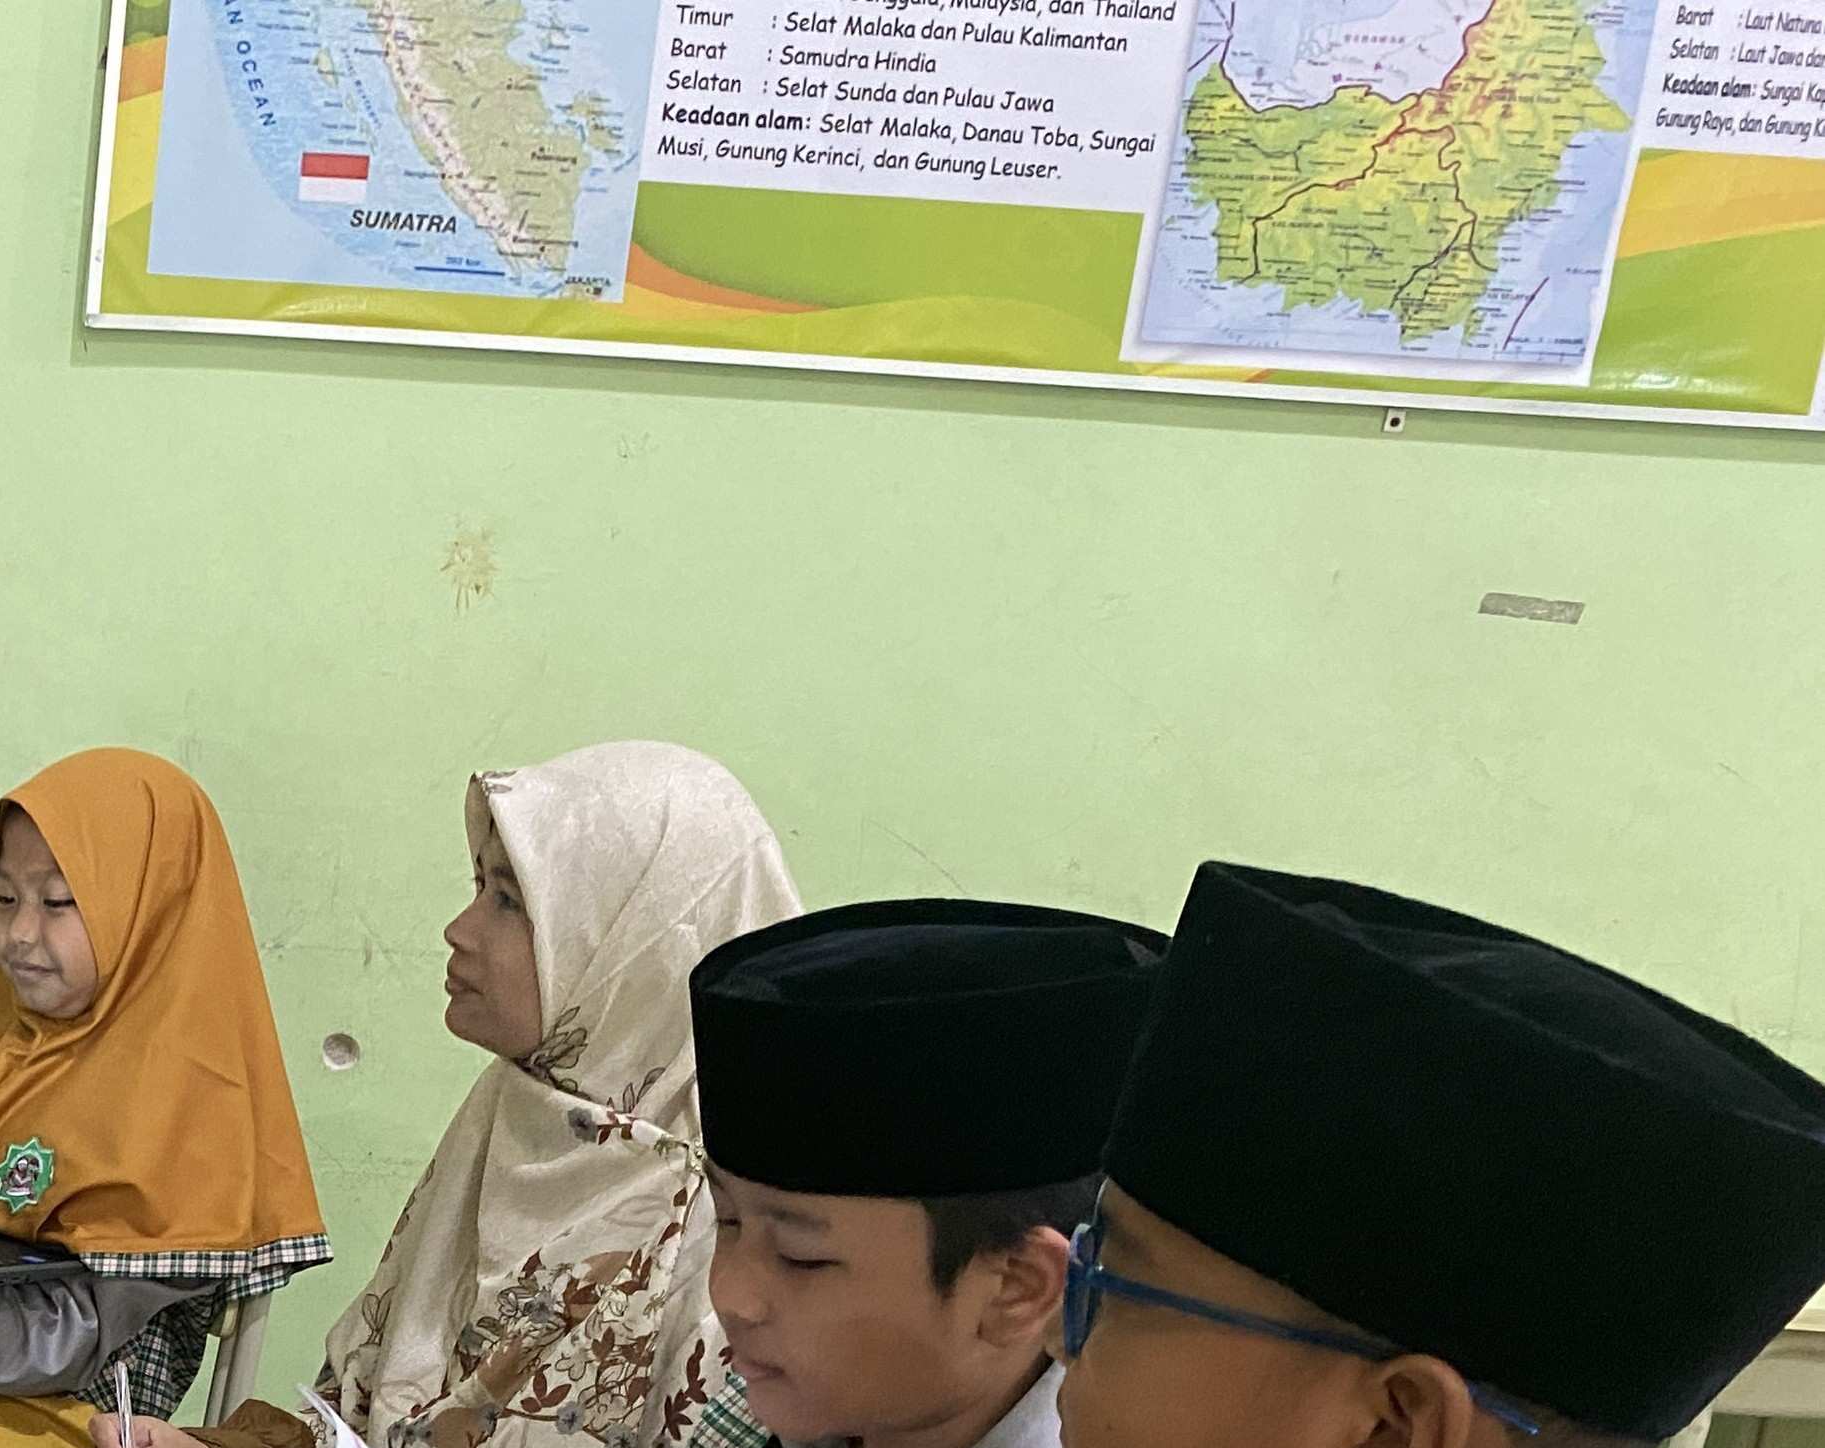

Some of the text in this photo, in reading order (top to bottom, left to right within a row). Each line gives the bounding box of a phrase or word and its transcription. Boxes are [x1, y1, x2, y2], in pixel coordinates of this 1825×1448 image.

[1049, 0, 1083, 15] dan
[1097, 0, 1176, 21] Thailand
[1676, 5, 1822, 34] Barat Laut Natuna
[677, 5, 1127, 51] Timur Selat Malaka dan Pulau Kalimantan
[671, 38, 935, 72] Barat Samudra Hindia
[1670, 38, 1719, 59] Selatan
[1738, 43, 1766, 63] Laut
[1769, 45, 1803, 66] Jawa
[236, 40, 277, 127] OCEAN
[667, 70, 1053, 112] Selatan Selat Sunda dan Pulau Jawa
[1663, 74, 1718, 95] Keadaan
[1721, 77, 1756, 98] alam:
[1761, 80, 1805, 106] Sungai
[662, 103, 1155, 156] Keadaan alam: Selat Malaka, Danau Toba, Sungai
[1656, 108, 1701, 135] Gunung
[1702, 110, 1735, 135] Raya,
[1739, 112, 1762, 132] dan
[1765, 115, 1811, 142] Gunung
[658, 136, 1060, 180] Musi, Gunung Kerinci, dan Gunung Leuser.
[349, 209, 458, 234] SUMATRA
